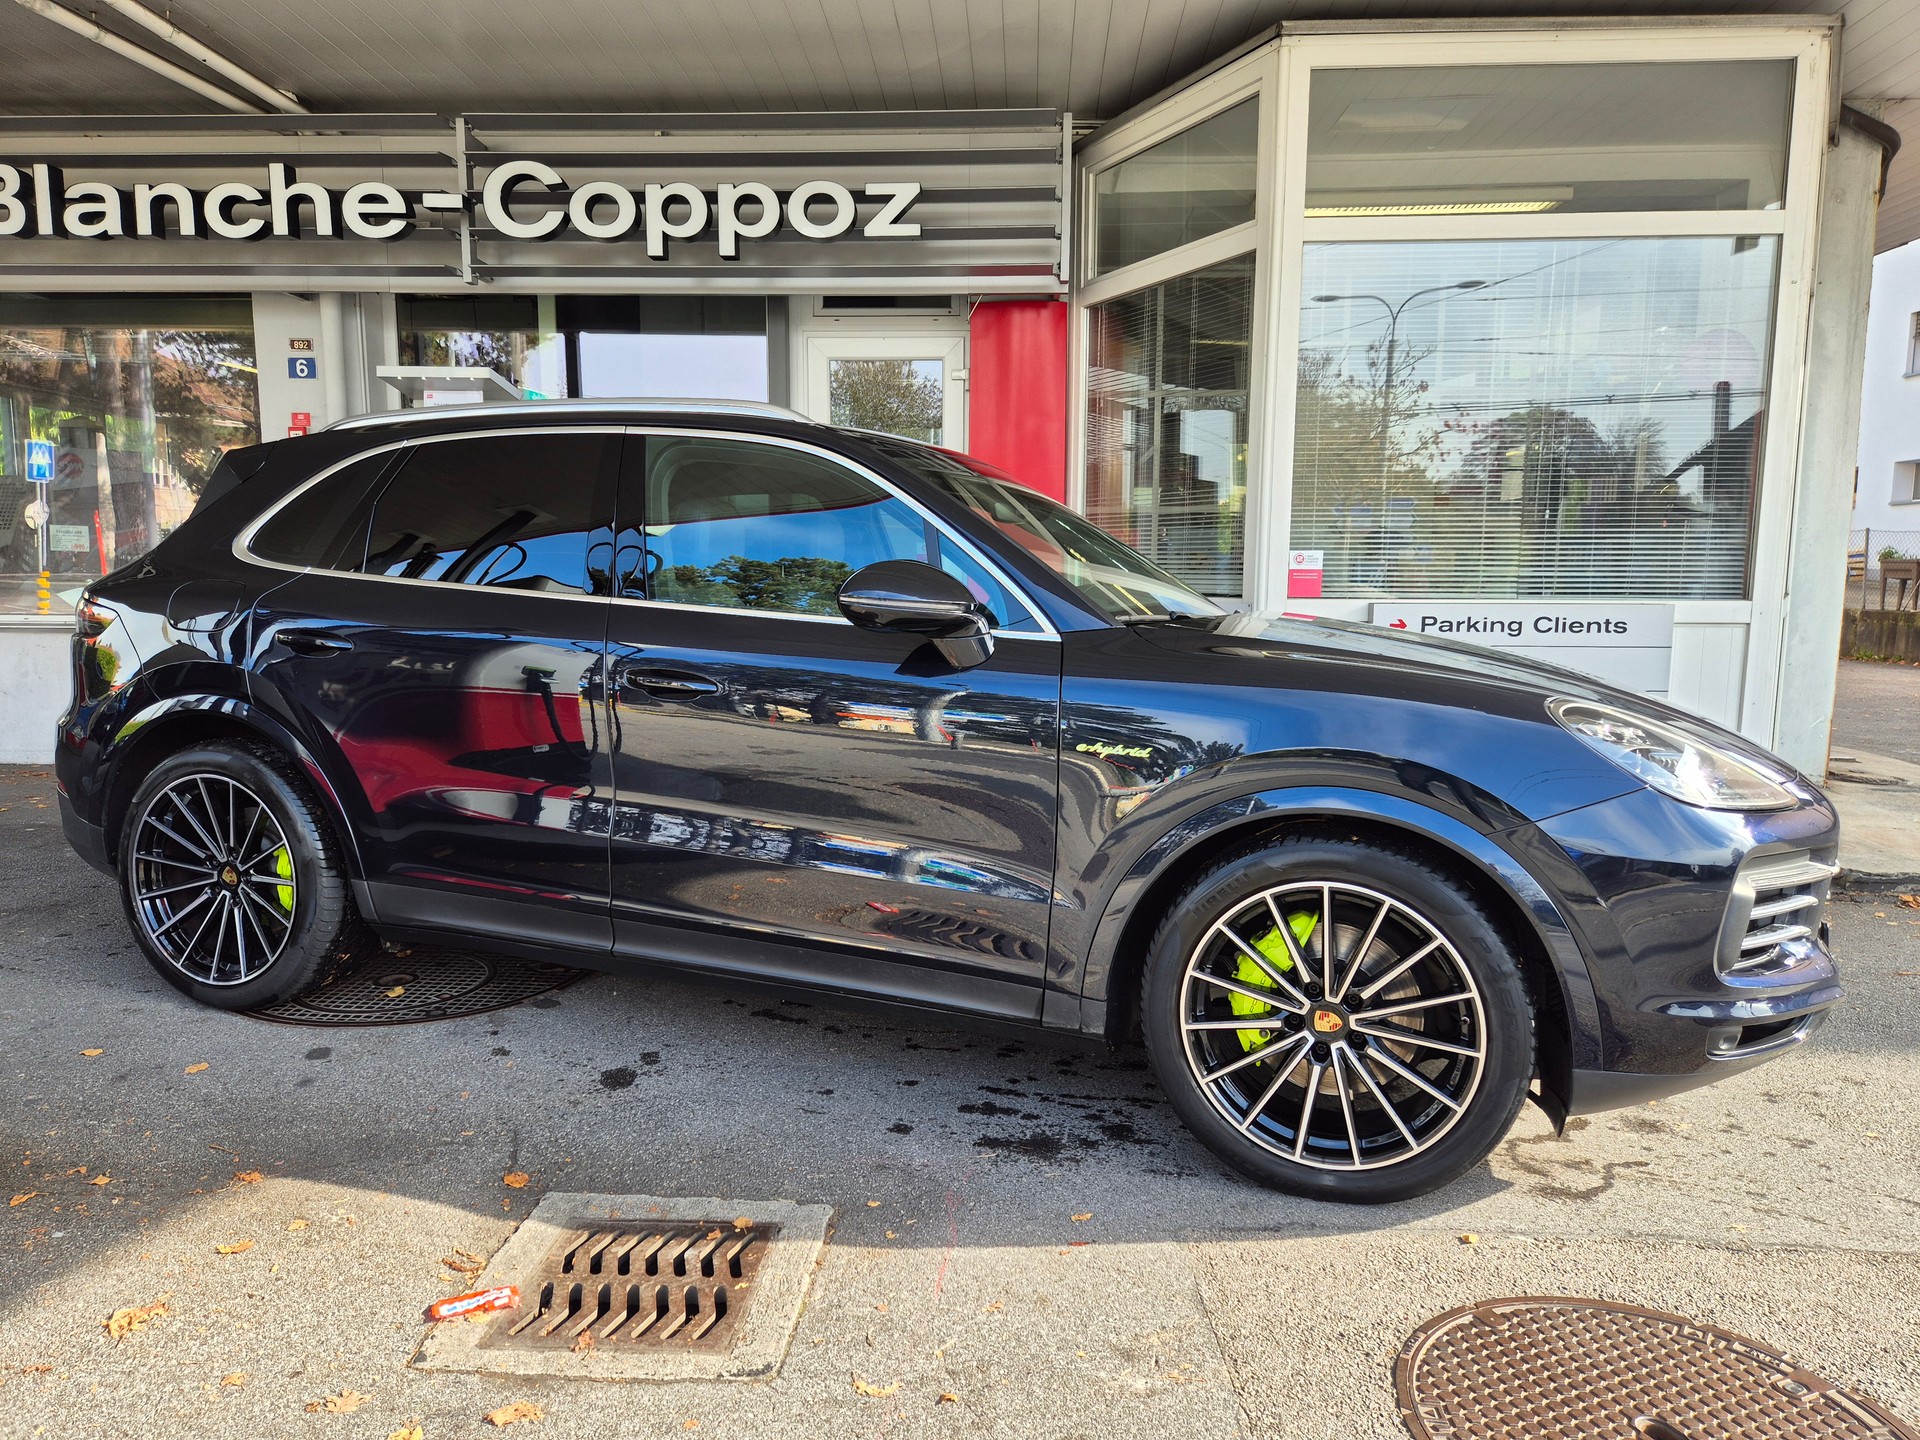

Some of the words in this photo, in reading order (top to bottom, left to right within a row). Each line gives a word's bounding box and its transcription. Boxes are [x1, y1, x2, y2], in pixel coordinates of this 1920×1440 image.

[293, 340, 309, 349] 892
[295, 359, 309, 377] 6
[1420, 615, 1523, 637] Parking
[1533, 615, 1628, 634] Clients
